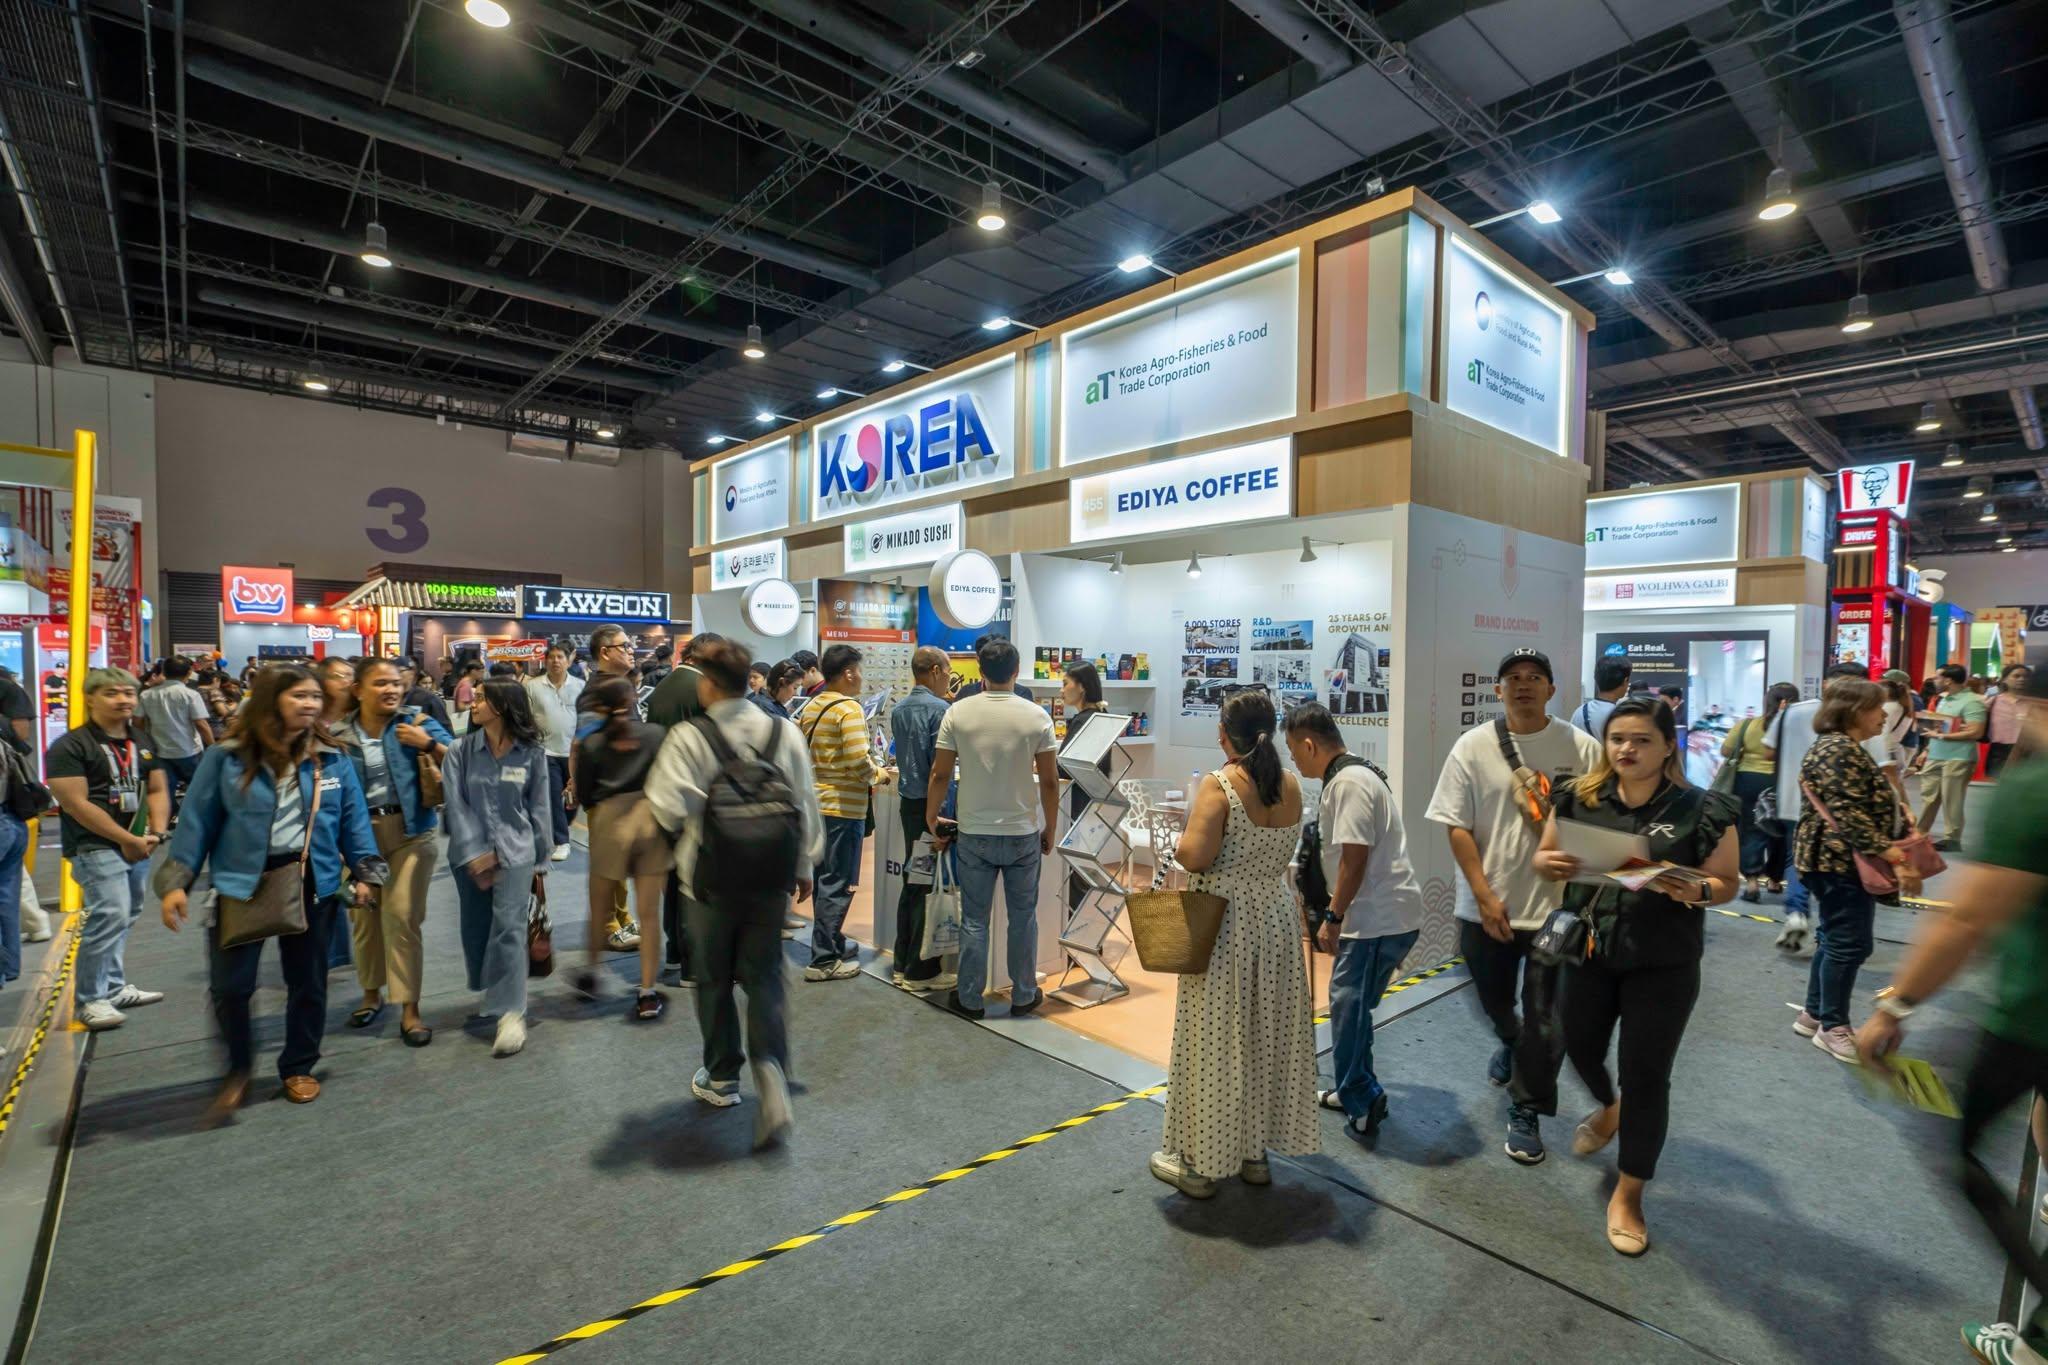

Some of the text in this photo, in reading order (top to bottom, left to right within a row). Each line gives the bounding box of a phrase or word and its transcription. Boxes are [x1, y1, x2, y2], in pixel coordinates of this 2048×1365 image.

[1119, 323, 1268, 379] Korea Agro-Fisheries & Food
[1119, 361, 1210, 395] Trade Corporation
[1467, 358, 1485, 385] aT
[1486, 364, 1499, 380] Korea
[1085, 370, 1115, 404] aT
[820, 392, 997, 499] KOREA
[1117, 467, 1279, 513] EDIYA COFFEE
[365, 486, 430, 553] 3
[1635, 519, 1688, 532] Agro-Fisheries
[1690, 518, 1696, 526] &
[1697, 516, 1718, 525] Food
[887, 523, 952, 549] MIKADO SUSHI
[1586, 527, 1608, 543] aT
[1611, 528, 1679, 541] Trade Corporation
[427, 584, 449, 595] 100
[450, 585, 497, 598] STORES
[950, 584, 996, 594] EDIYA COFFEE
[1637, 581, 1691, 592] WOLHWA
[1693, 578, 1728, 589] GALBI
[535, 591, 662, 617] LAWSON
[1252, 617, 1272, 626] R&D
[1328, 612, 1387, 623] 25 YEARS OF
[1839, 609, 1872, 620] ORDER
[1209, 618, 1241, 628] STORES
[1328, 623, 1391, 633] GROWTH AN
[1474, 613, 1540, 633] BRAND LOCATIONS
[826, 630, 848, 638] MENU
[1252, 628, 1286, 638] CENTER
[1187, 645, 1240, 655] WORLDWIDE
[1628, 643, 1643, 652] Eat
[1644, 643, 1667, 652] Real.
[1278, 681, 1313, 691] DREAM
[1333, 716, 1389, 727] XCELLENCE
